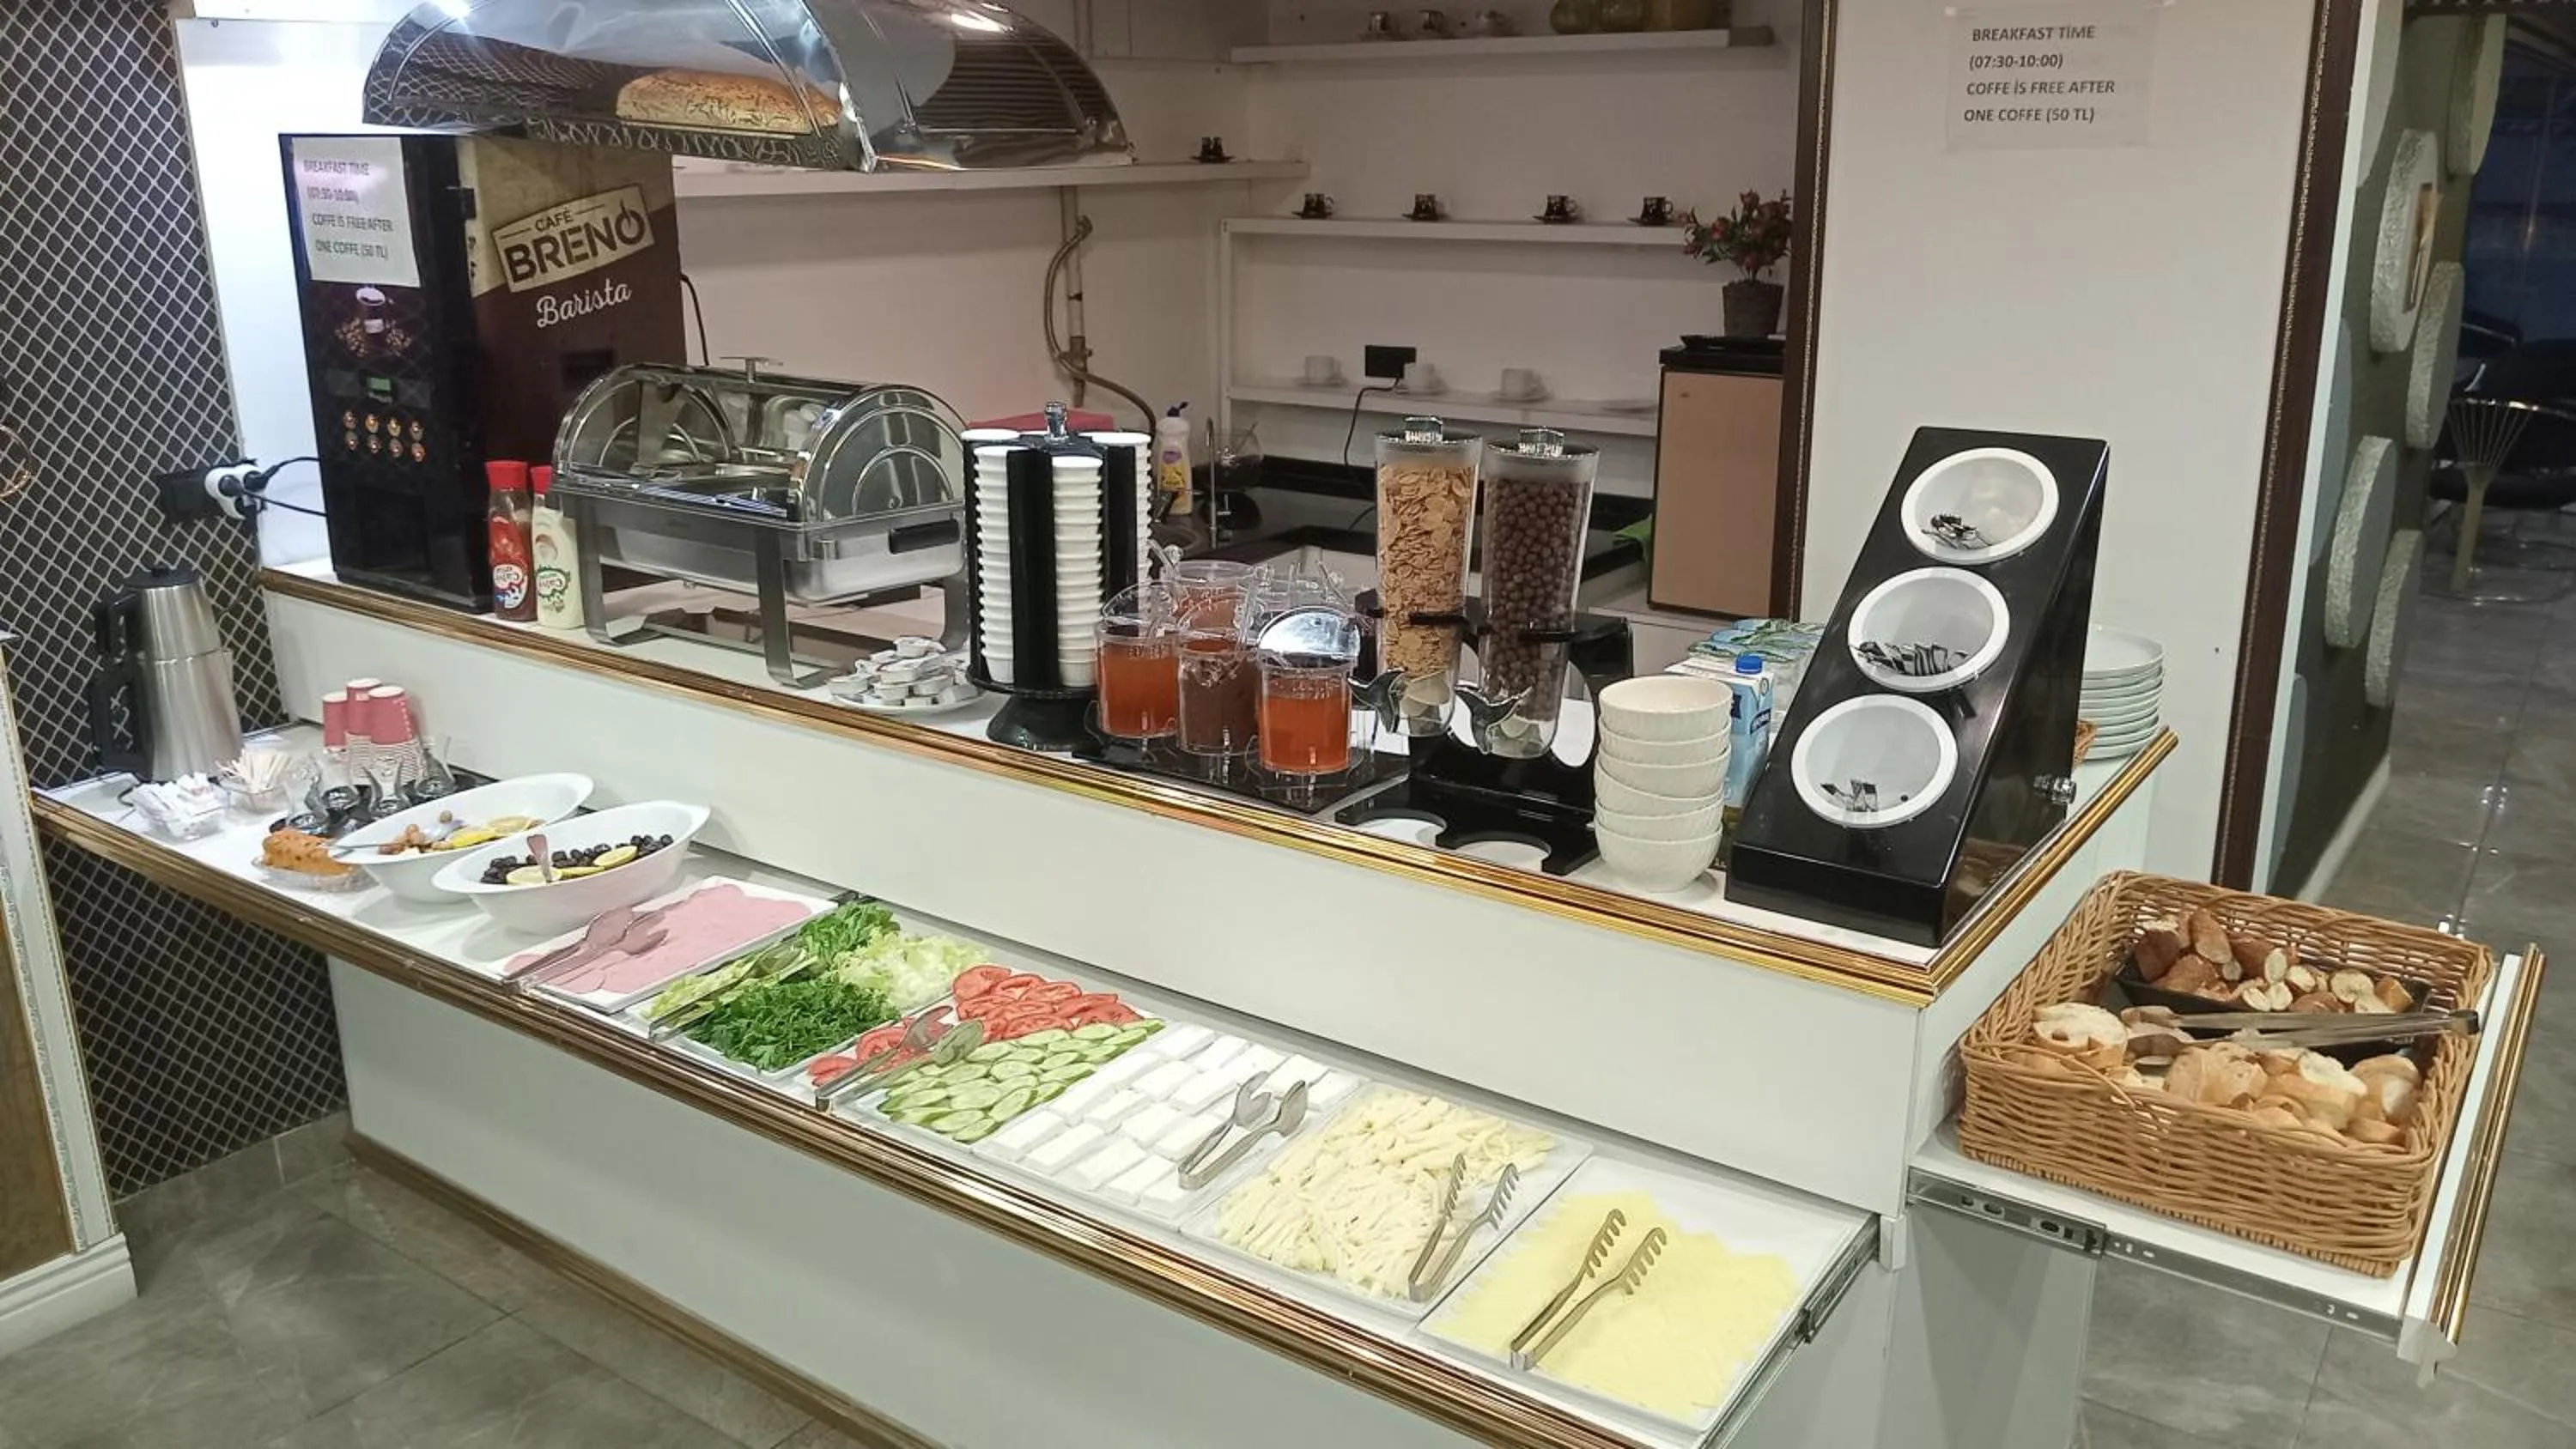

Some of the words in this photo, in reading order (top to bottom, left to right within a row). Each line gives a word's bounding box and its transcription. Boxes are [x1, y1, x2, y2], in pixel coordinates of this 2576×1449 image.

[1972, 27, 2054, 42] BREAKFAST
[1969, 53, 2063, 70] (07:30-10:00)
[1966, 82, 2010, 95] COFFE
[2030, 81, 2066, 94] FREE
[2068, 80, 2116, 94] AFTER
[1964, 108, 1995, 122] ONE
[1997, 108, 2043, 122] COFFE
[2045, 106, 2070, 124] (50
[2073, 106, 2095, 124] TL)
[503, 198, 646, 283] BRENO
[536, 277, 633, 329] Barista
